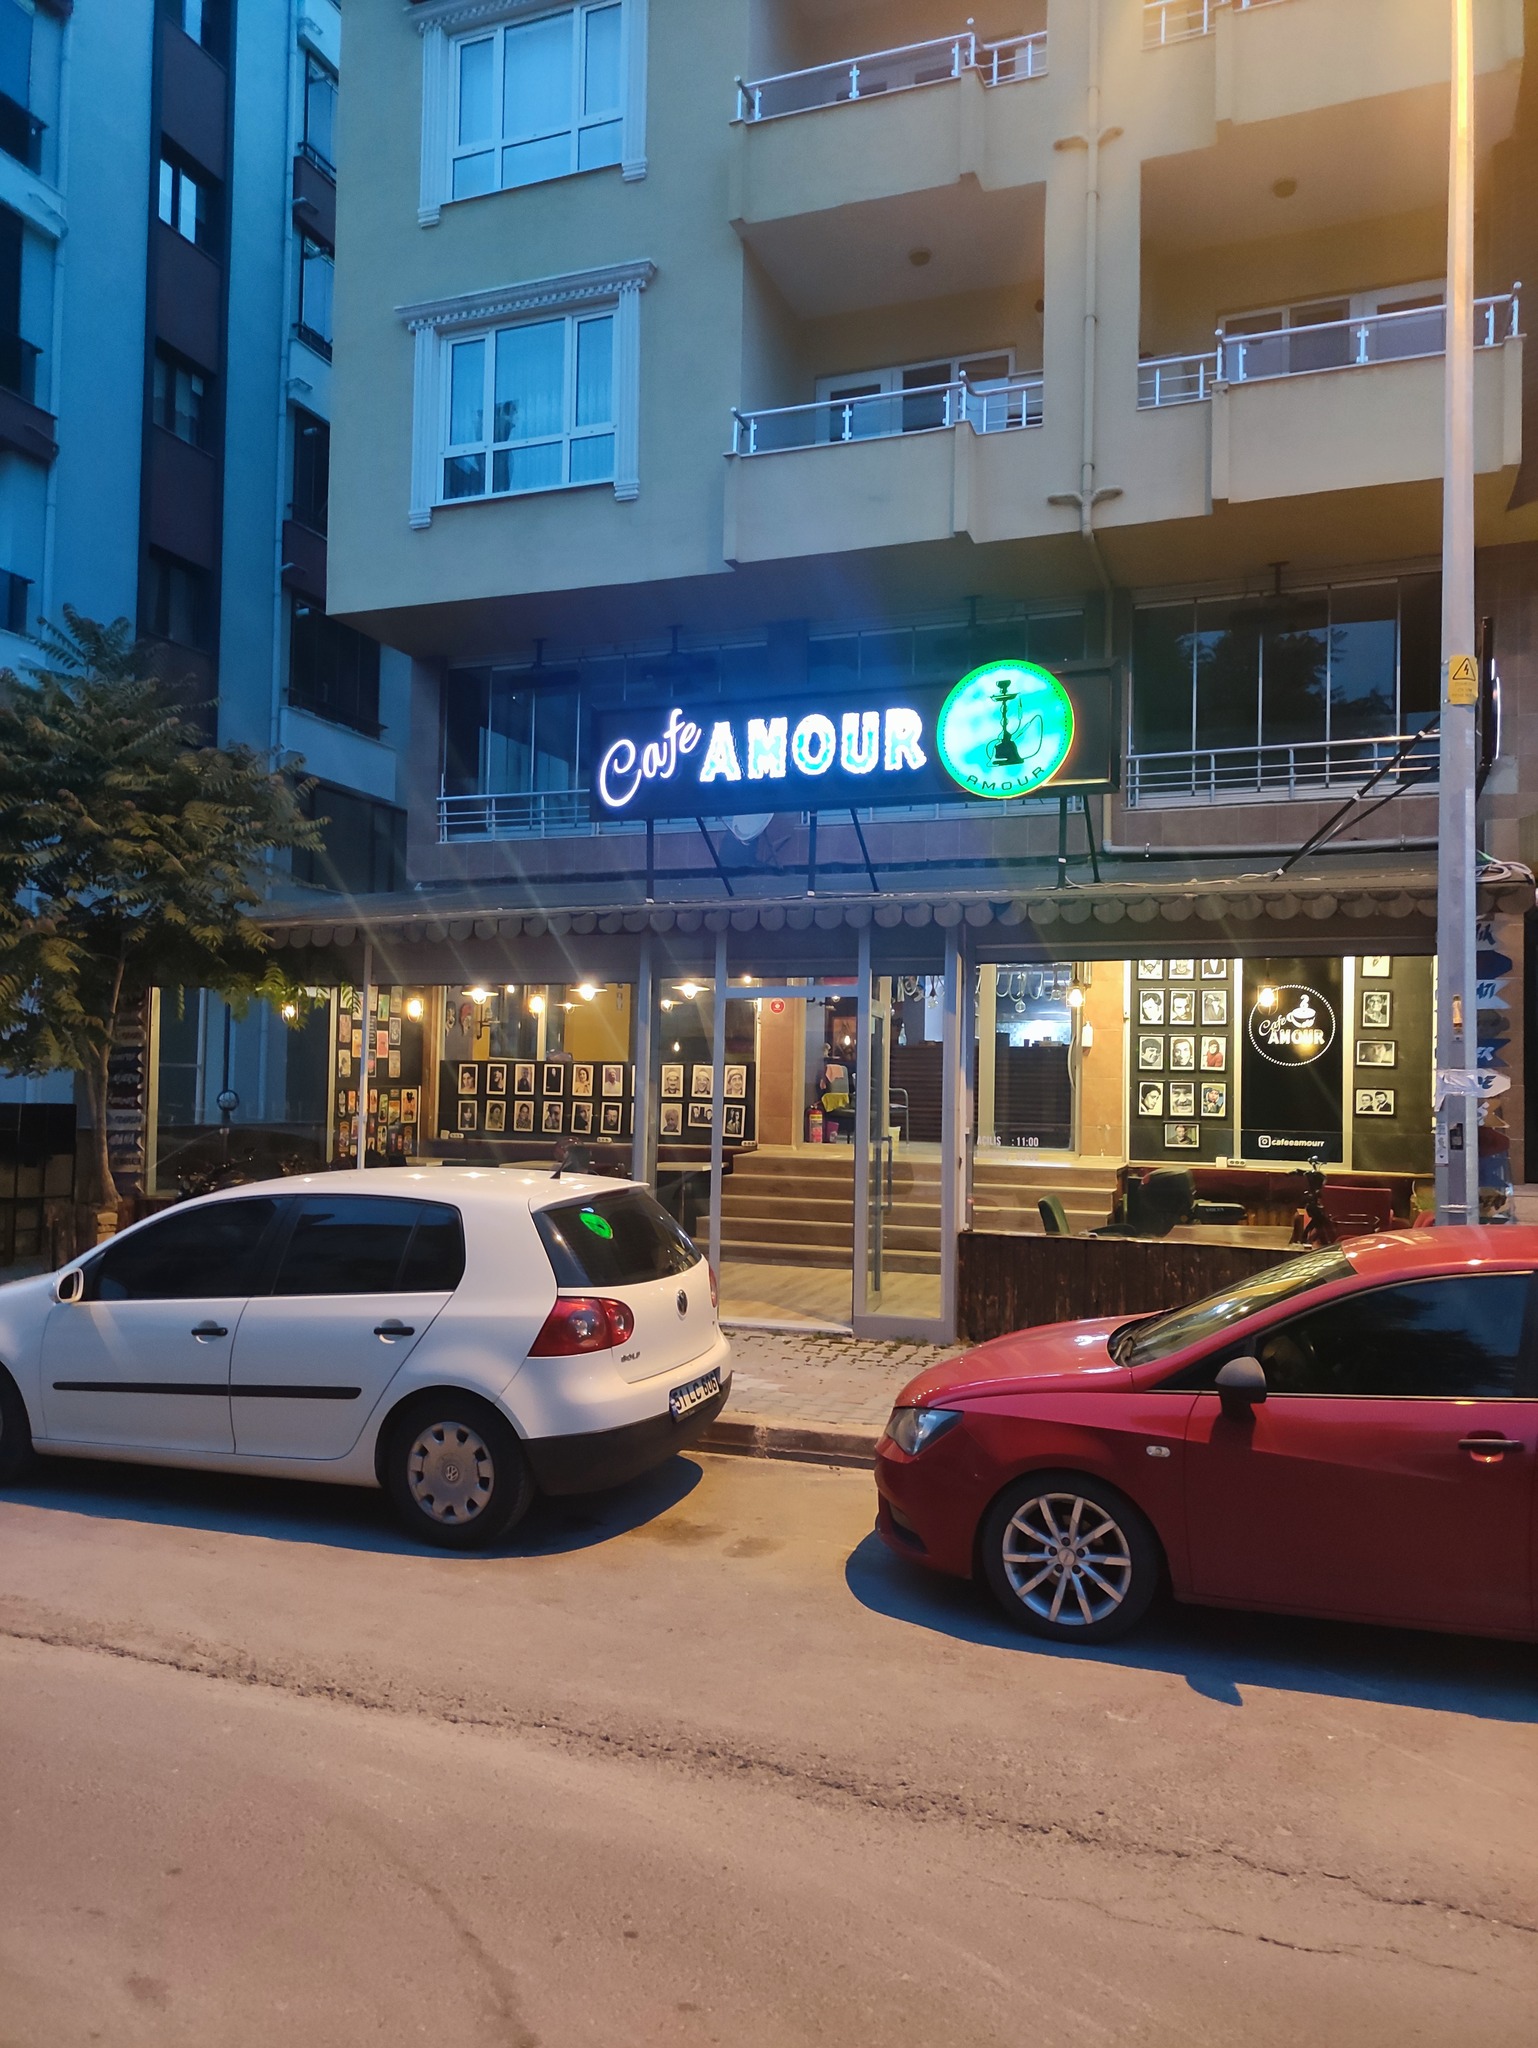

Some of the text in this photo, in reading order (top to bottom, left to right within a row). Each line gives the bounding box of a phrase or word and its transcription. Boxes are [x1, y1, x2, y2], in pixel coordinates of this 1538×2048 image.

[599, 707, 927, 808] Cafe AMOUR
[966, 766, 1045, 791] AMOUR
[1258, 1014, 1287, 1037] Cafe
[1267, 1028, 1326, 1045] AMOUR
